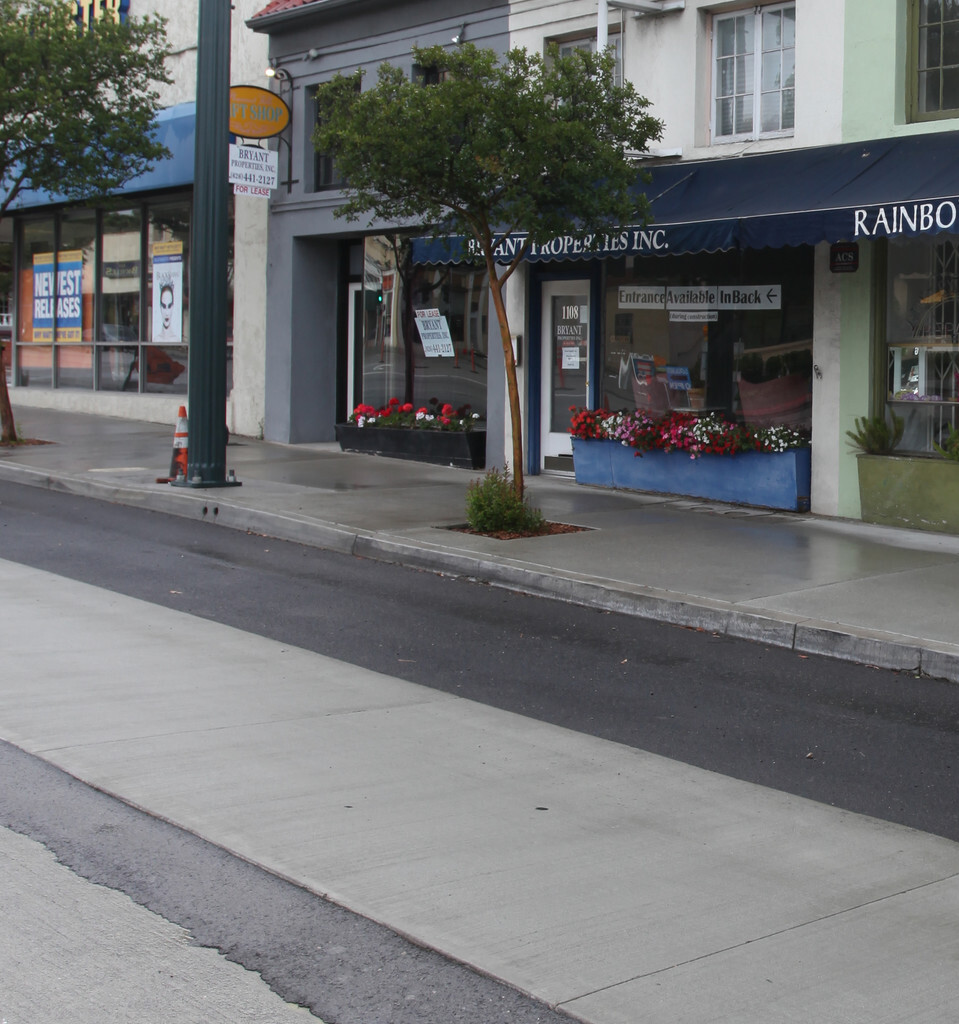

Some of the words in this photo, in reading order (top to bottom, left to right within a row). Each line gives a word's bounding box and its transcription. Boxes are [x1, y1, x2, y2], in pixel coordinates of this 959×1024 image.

[249, 103, 283, 123] SHOP
[239, 148, 270, 163] BRYANT
[235, 184, 249, 194] FOR
[250, 186, 270, 197] LEASE
[530, 231, 629, 255] PROPERIES
[631, 229, 669, 250] INC.
[835, 251, 854, 263] ACS
[34, 269, 81, 297] NEWEST
[618, 290, 665, 304] Entrance
[666, 289, 716, 305] Available
[417, 310, 426, 318] FOR
[426, 310, 439, 318] LEASE
[562, 305, 579, 320] 1108
[421, 319, 442, 331] BRYANT
[556, 325, 583, 335] BRYANT
